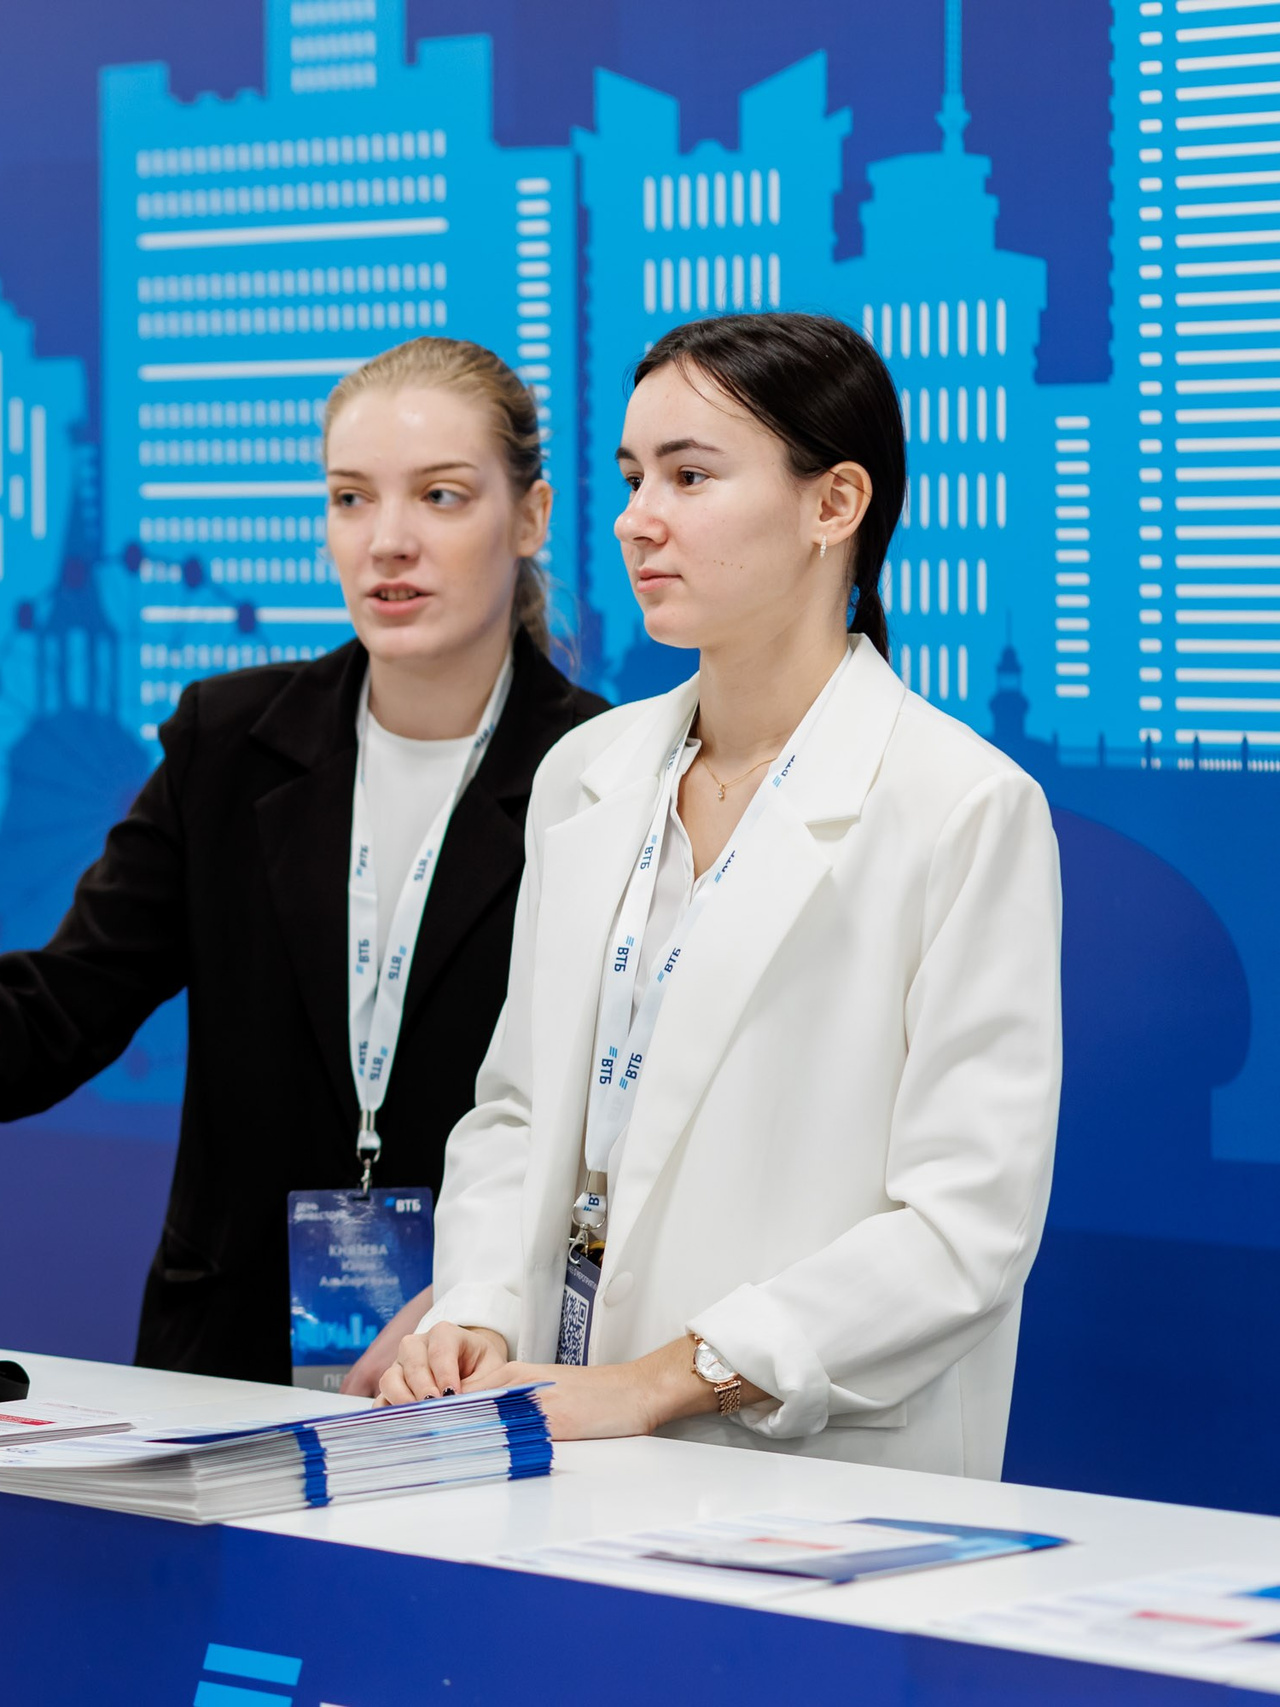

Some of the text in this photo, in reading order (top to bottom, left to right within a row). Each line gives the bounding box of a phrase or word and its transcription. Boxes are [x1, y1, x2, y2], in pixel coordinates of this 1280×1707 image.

[639, 846, 654, 870] ВТБ
[358, 939, 370, 963] ВТБ
[614, 946, 629, 972] ВТБ
[663, 947, 681, 973] ВТБ
[388, 956, 402, 980] ВТБ
[369, 1057, 384, 1081] ВТБ
[599, 1058, 614, 1085] ВТБ
[625, 1052, 643, 1080] ВТБ
[395, 1198, 422, 1213] ВТБ
